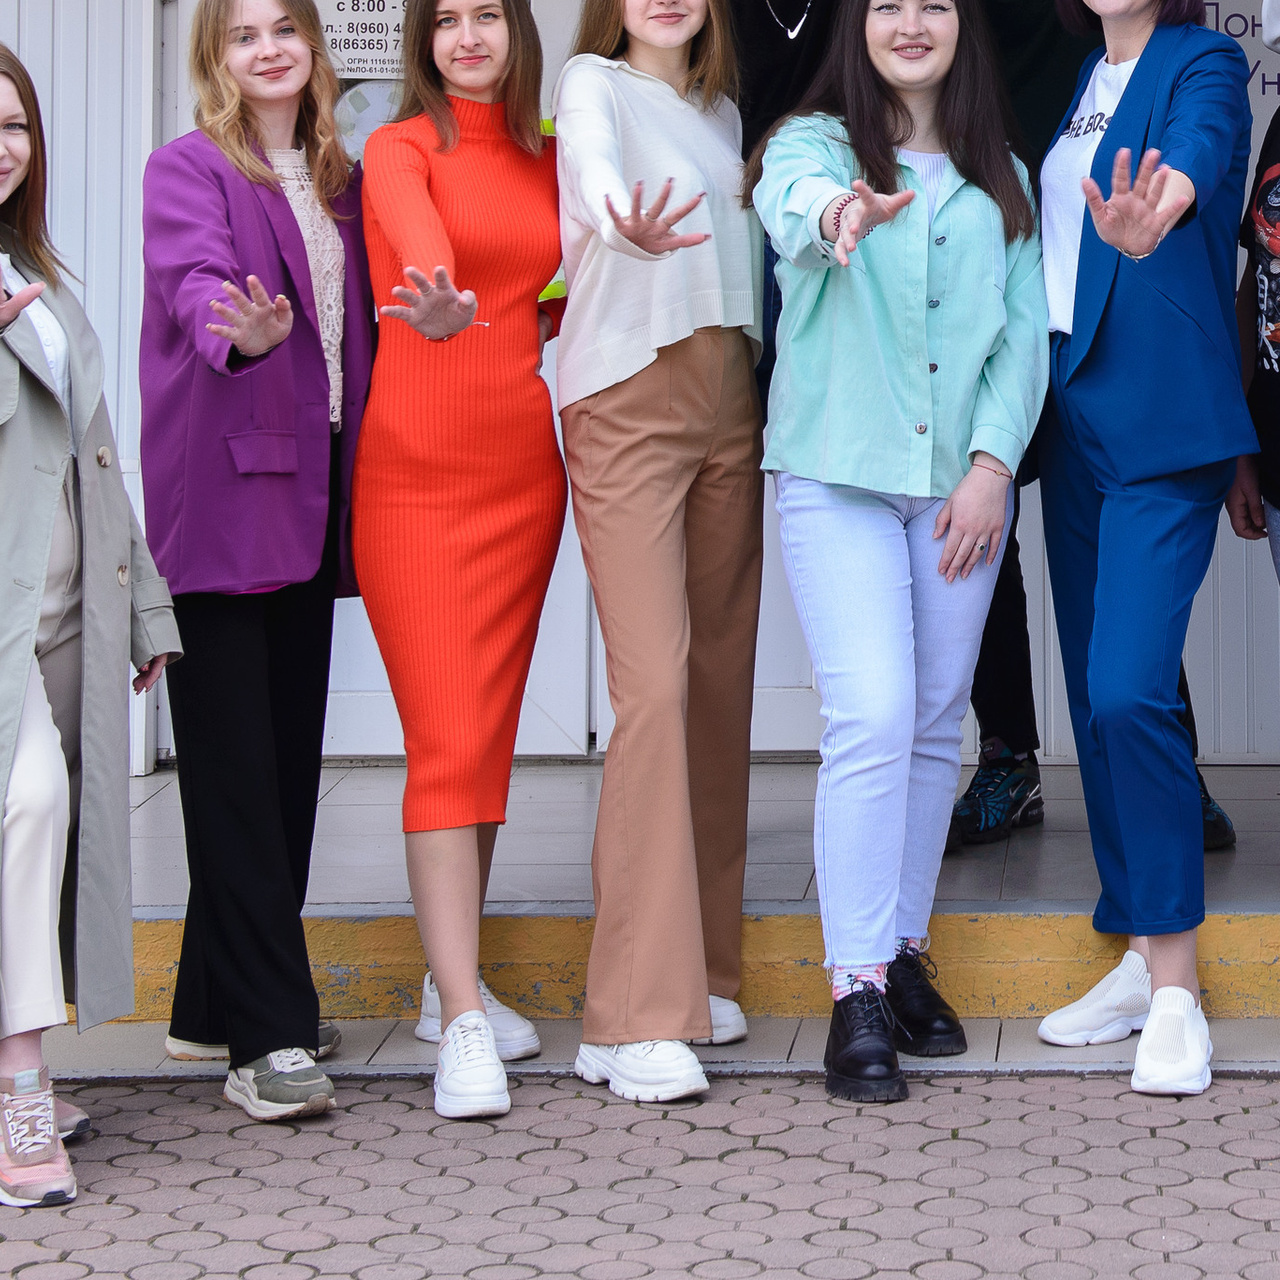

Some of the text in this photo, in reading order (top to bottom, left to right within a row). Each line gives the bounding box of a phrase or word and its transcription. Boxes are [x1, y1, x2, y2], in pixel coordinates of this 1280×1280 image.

[336, 1, 346, 12] с
[351, 0, 386, 13] 8:00
[347, 22, 389, 36] 8(960)
[330, 38, 388, 53] 8(86365)
